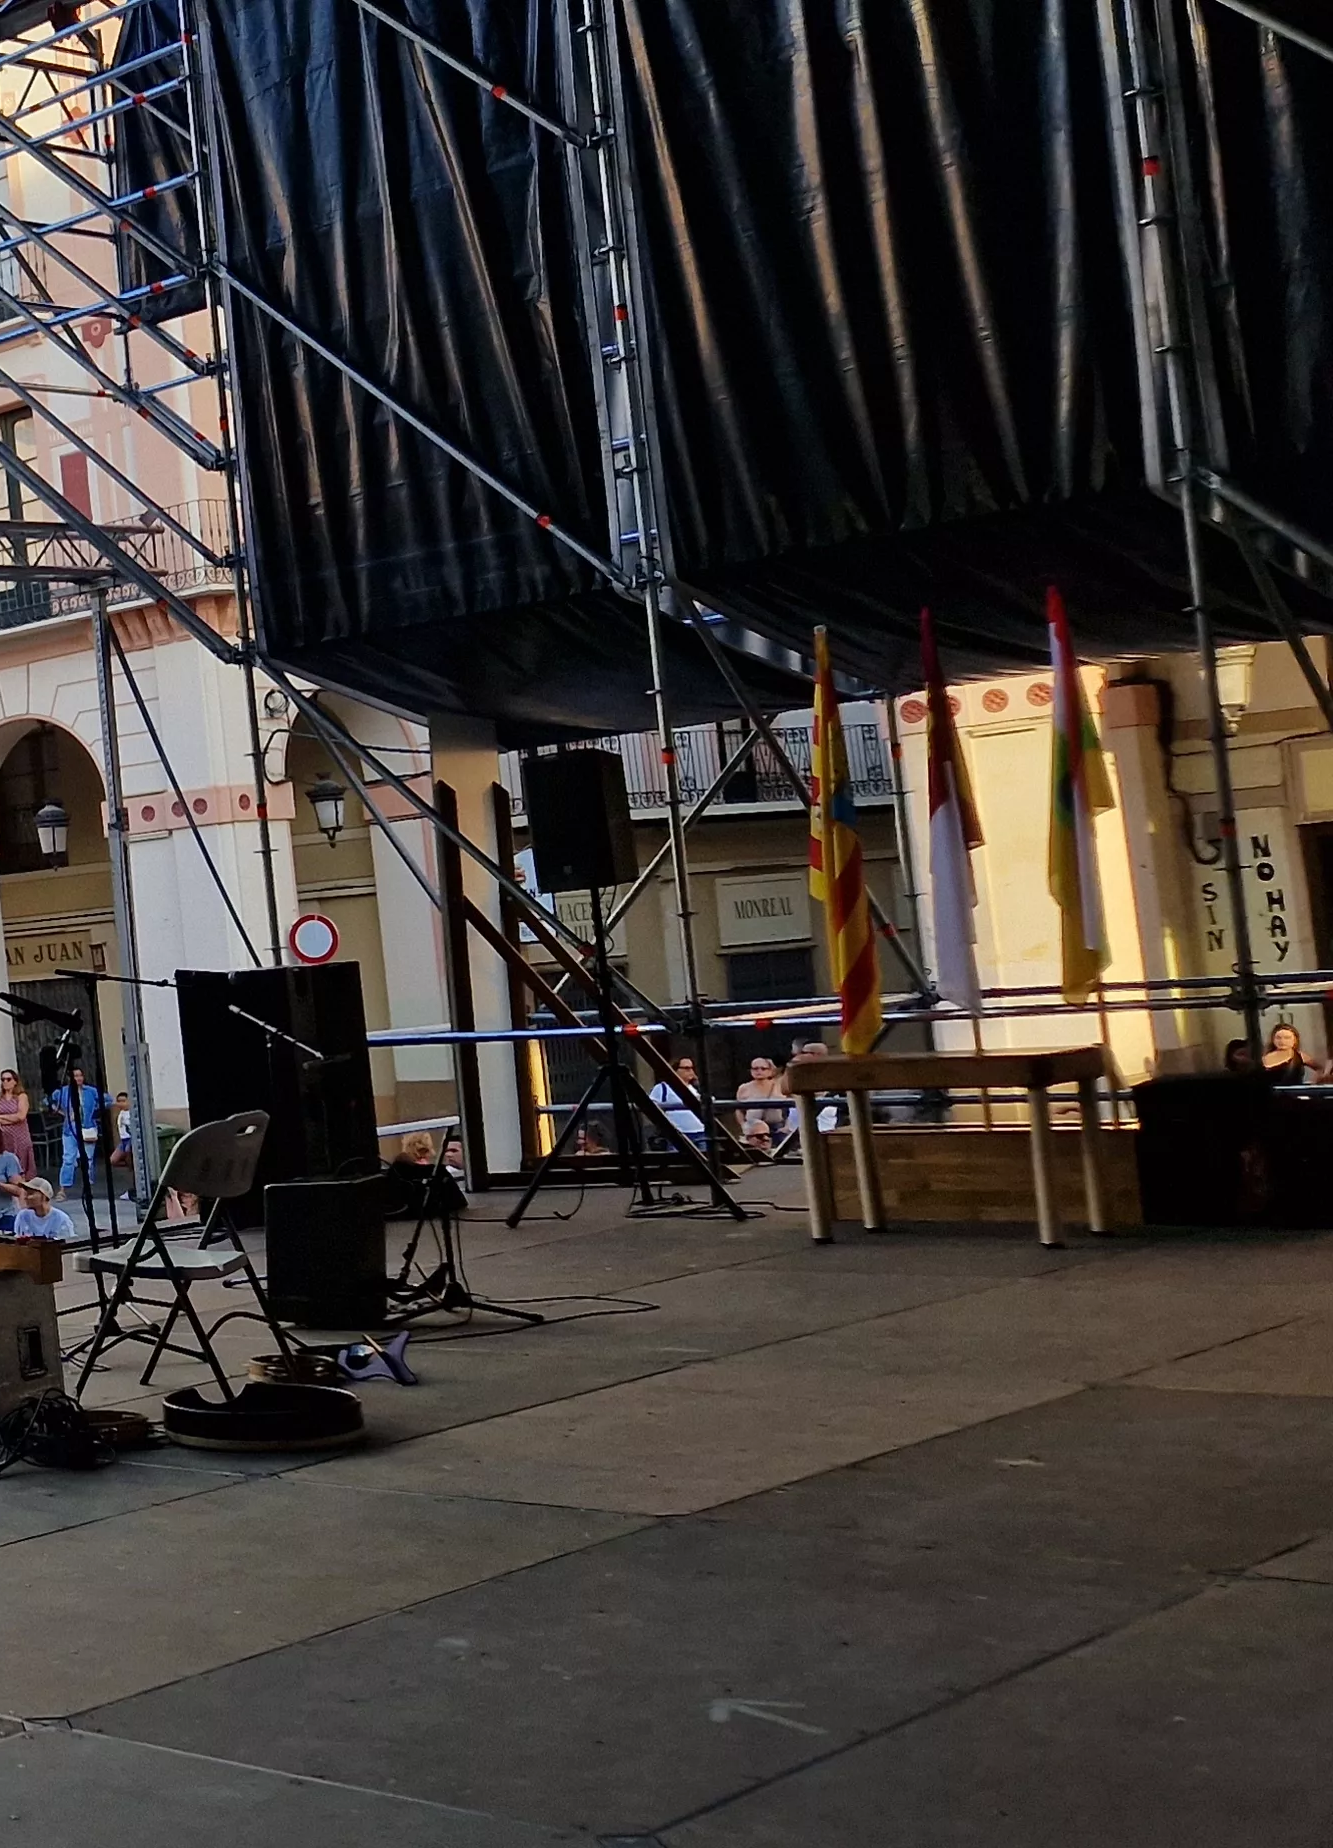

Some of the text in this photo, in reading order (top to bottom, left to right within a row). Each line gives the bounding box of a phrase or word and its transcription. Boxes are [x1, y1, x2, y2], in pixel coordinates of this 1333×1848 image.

[733, 896, 795, 920] MONREAL
[1201, 882, 1225, 952] SIN
[1250, 834, 1290, 963] NO HAY
[33, 940, 84, 963] JUAN
